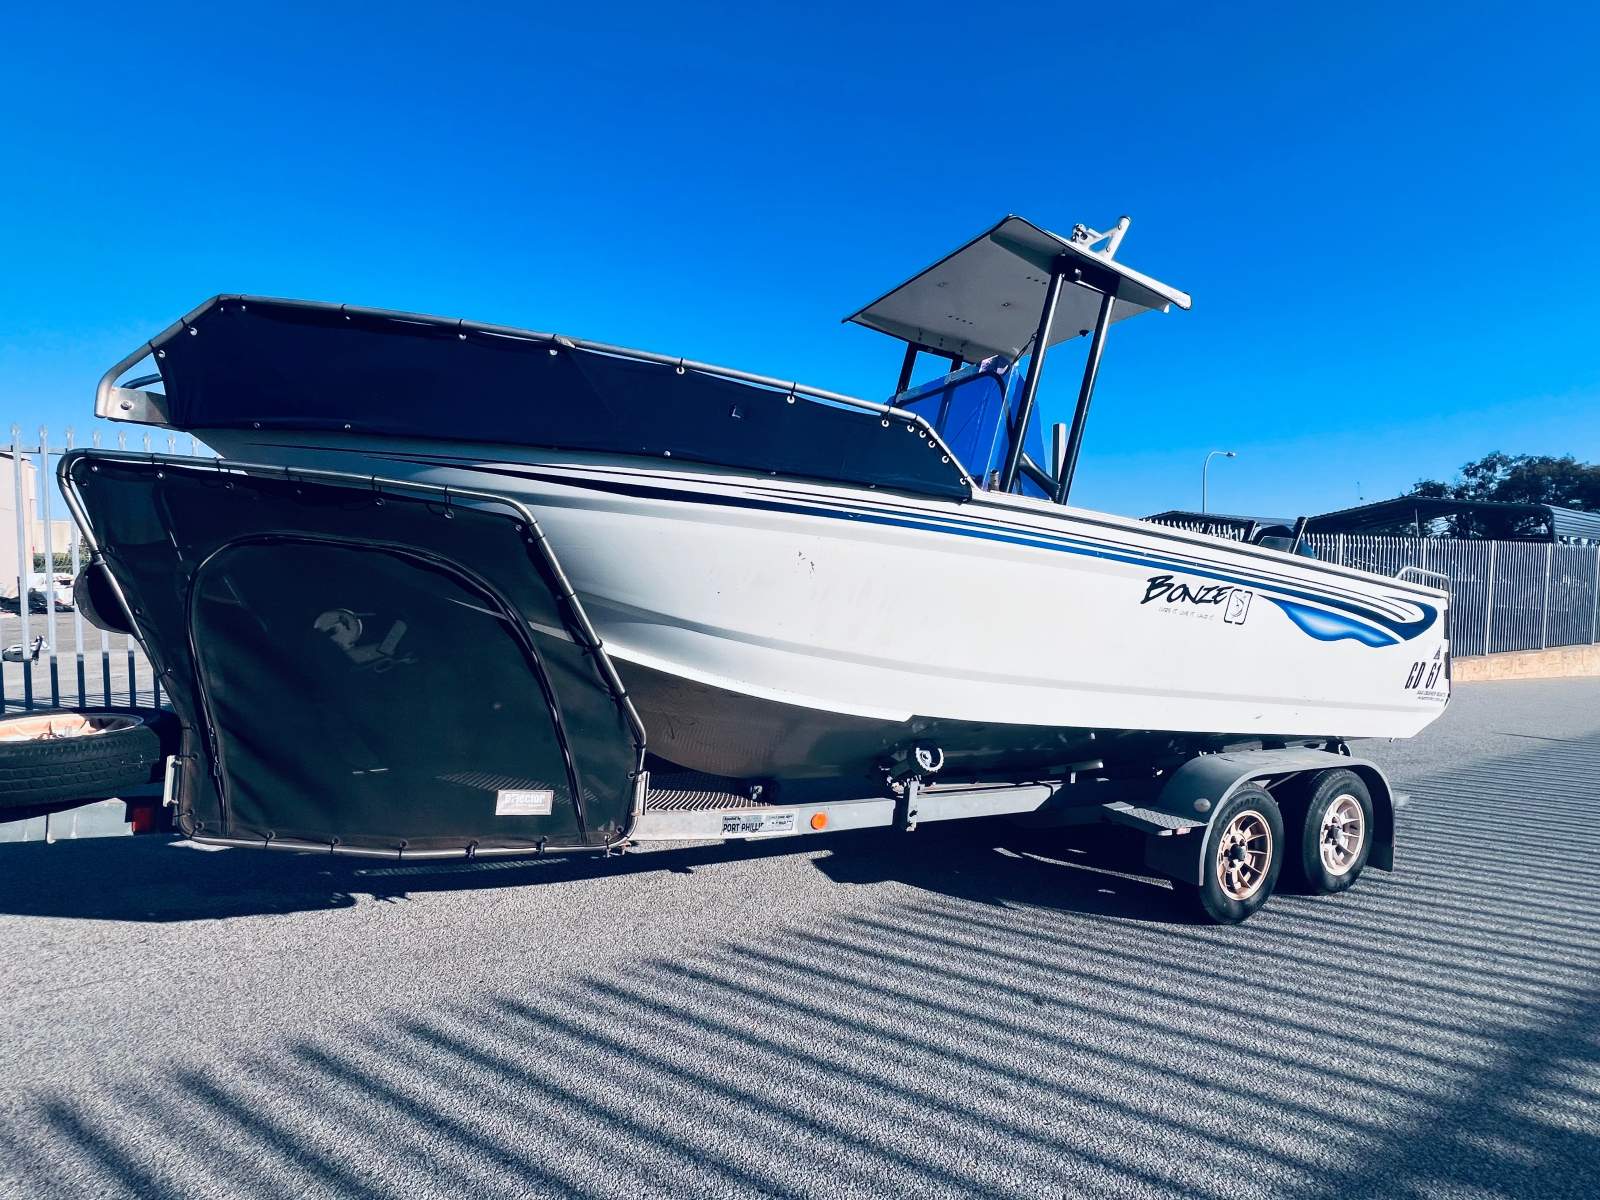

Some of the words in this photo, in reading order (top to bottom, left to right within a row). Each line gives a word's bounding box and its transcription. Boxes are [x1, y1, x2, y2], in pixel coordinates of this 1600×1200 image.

[1140, 575, 1234, 604] BONZE
[1426, 662, 1442, 689] 61
[723, 823, 739, 832] PORT
